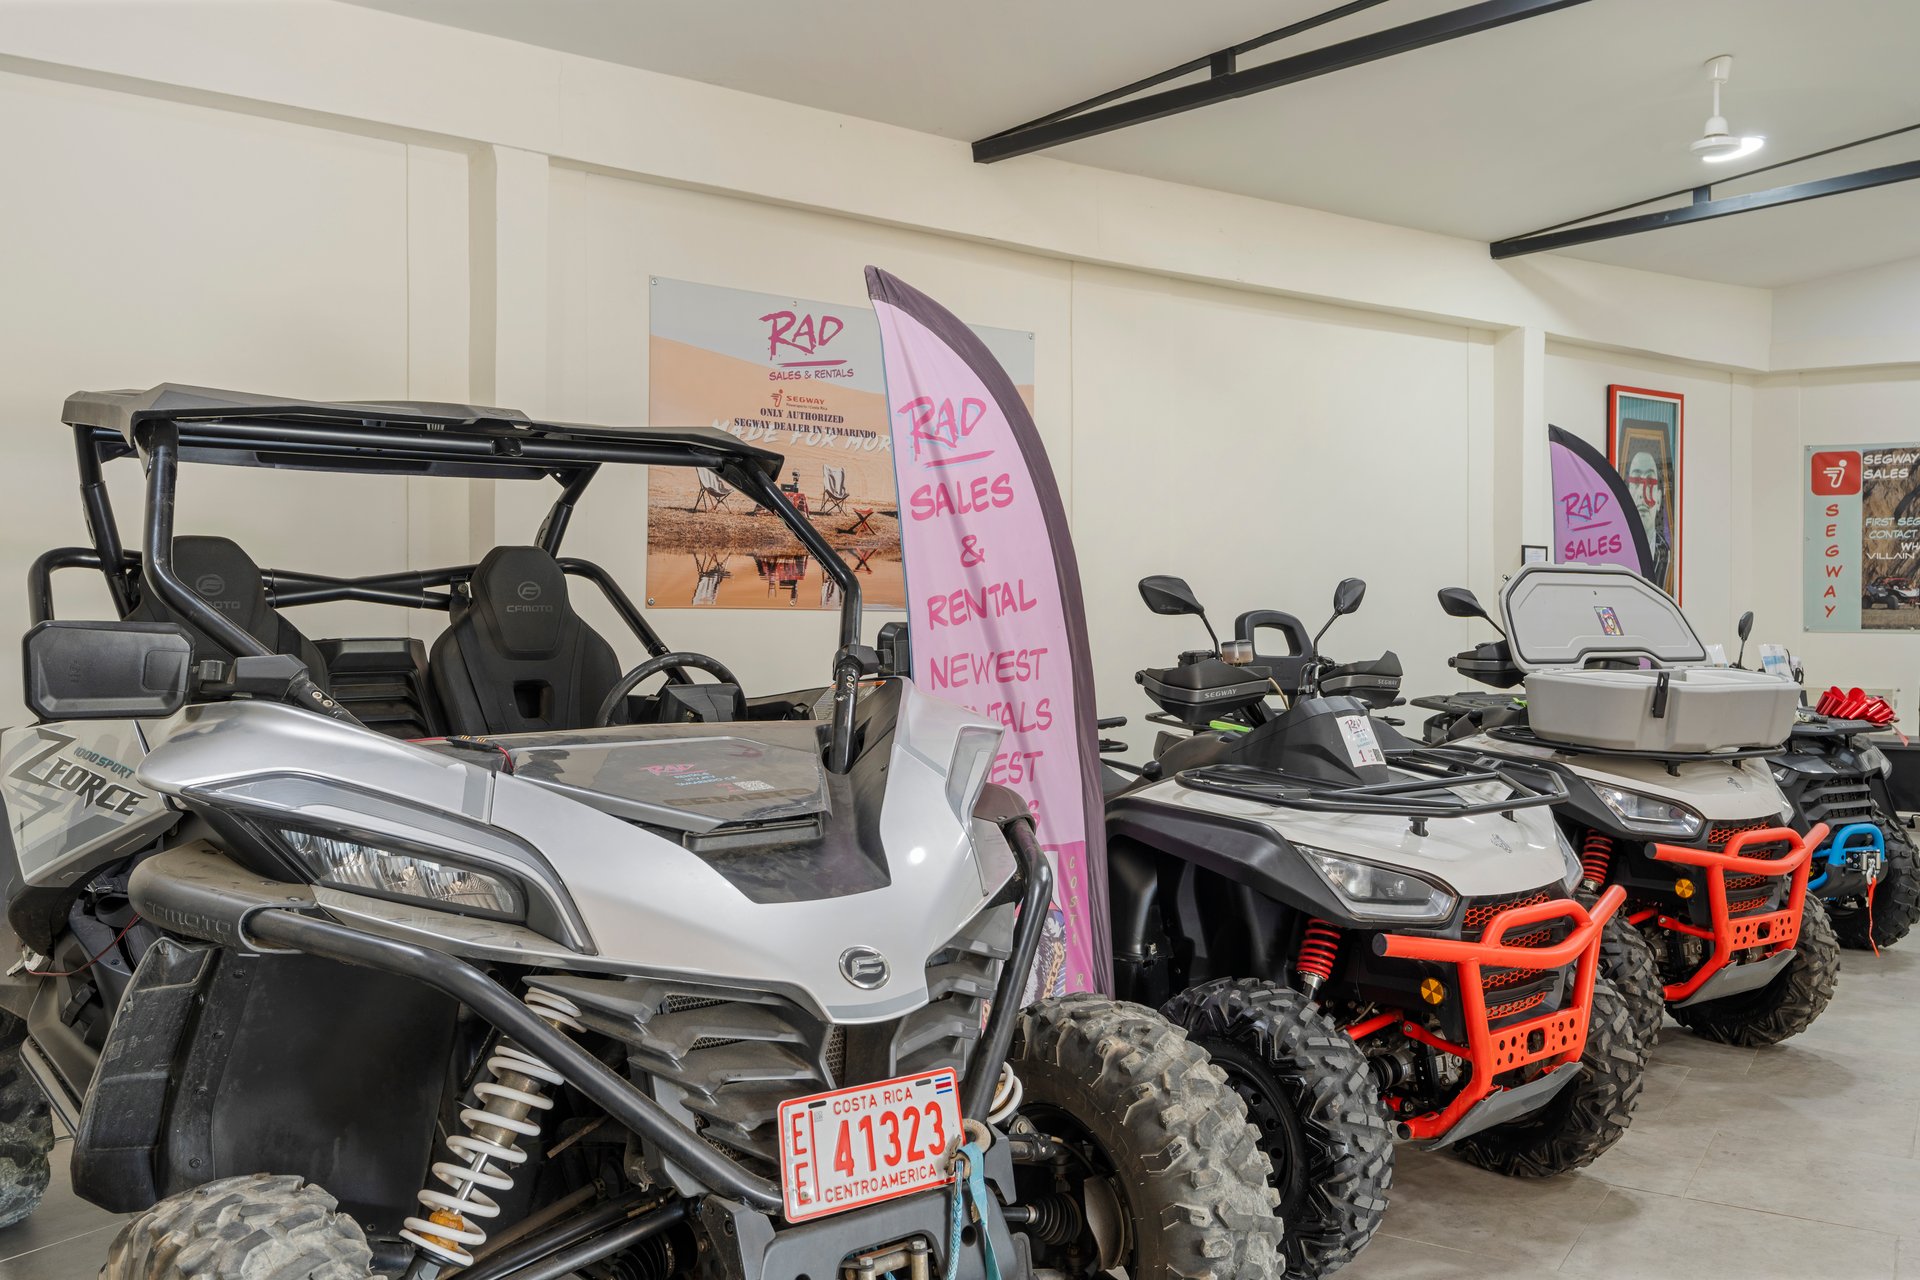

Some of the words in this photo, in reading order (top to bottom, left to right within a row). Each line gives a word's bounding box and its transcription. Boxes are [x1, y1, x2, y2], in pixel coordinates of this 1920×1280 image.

[759, 310, 844, 360] RAD
[769, 371, 802, 381] SALES
[804, 371, 812, 379] &
[814, 368, 855, 379] RENTALS
[786, 395, 825, 405] SEGWAY
[734, 417, 771, 430] SEGWAY
[774, 421, 810, 433] DEALER
[812, 425, 822, 435] IN
[825, 426, 877, 439] TAMARINDO
[760, 407, 784, 418] ONLY
[787, 411, 844, 424] AUTHORIZED
[897, 396, 987, 462] RAD
[789, 430, 838, 449] FOR
[844, 434, 892, 454] MOR
[1863, 453, 1920, 465] SEGWAY
[1863, 468, 1909, 479] SALES
[910, 473, 1014, 521] SALES
[1560, 492, 1609, 528] RAD
[1866, 517, 1895, 527] FIRST
[1869, 529, 1918, 539] CONTACT
[960, 534, 985, 568] &
[1564, 534, 1622, 560] SALES
[1824, 503, 1843, 618] SEGWAY
[1866, 552, 1915, 560] VILLAIN
[926, 578, 1037, 630] RENTAL
[930, 647, 1048, 690] NEWEST
[1204, 688, 1237, 699] SEGWAY
[74, 747, 99, 763] 1000
[96, 756, 135, 779] SPORT
[991, 751, 1044, 785] EST
[833, 1094, 877, 1115] COSTA
[883, 1087, 913, 1107] RICA
[833, 1101, 946, 1178] 41323
[825, 1163, 936, 1203] CENTROAMERICA
